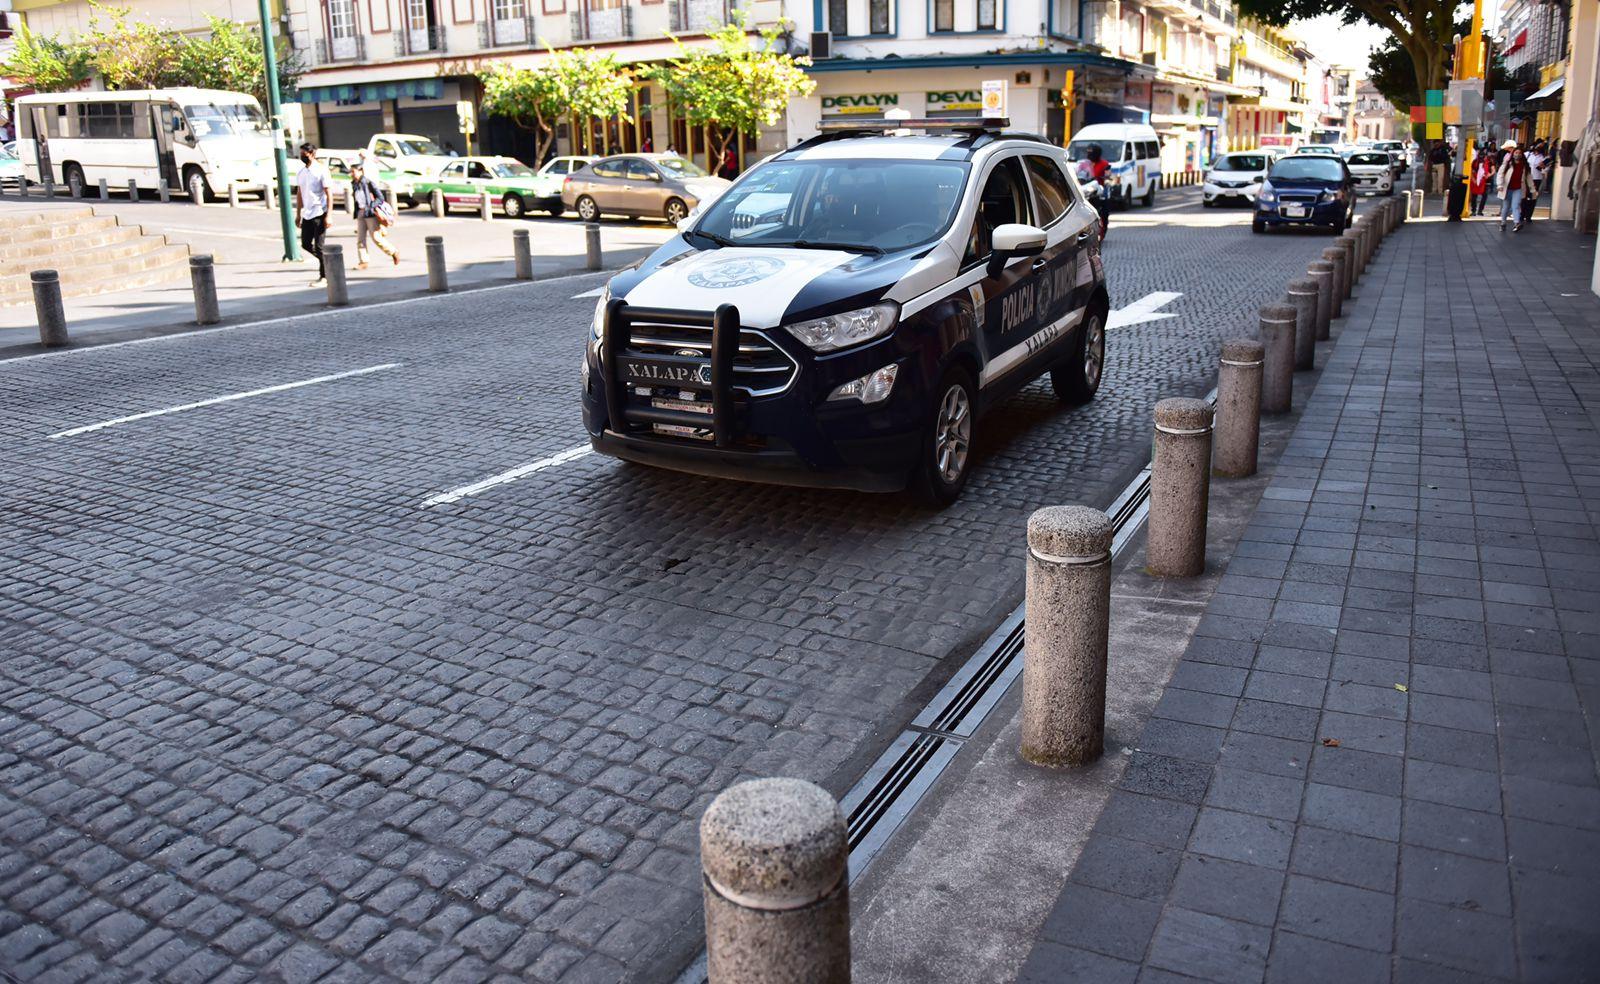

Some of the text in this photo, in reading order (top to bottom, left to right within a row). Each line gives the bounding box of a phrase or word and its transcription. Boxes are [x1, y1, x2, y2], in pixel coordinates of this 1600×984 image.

[822, 94, 898, 108] DEVLYN
[1001, 283, 1034, 335] POLICIA
[1024, 324, 1059, 356] XALAPA
[628, 363, 701, 382] XALAPA
